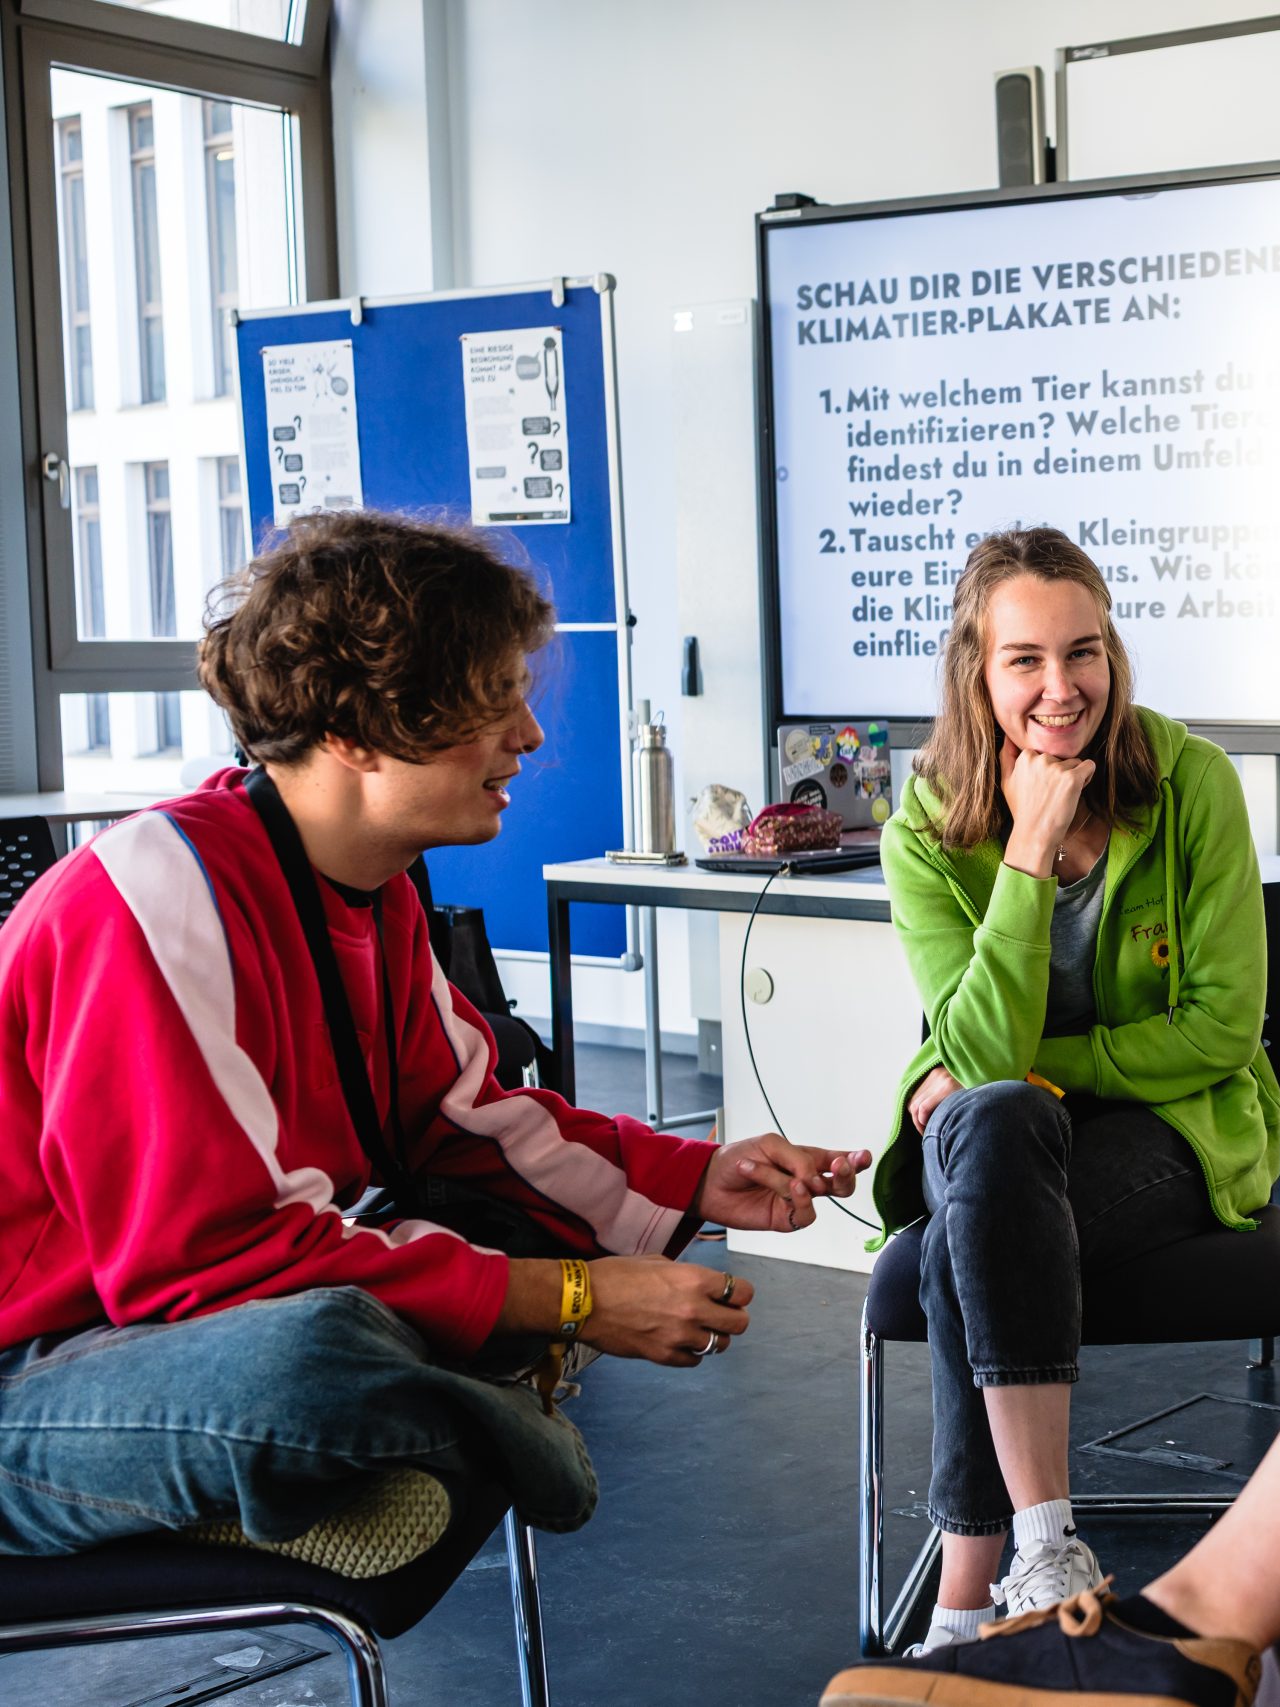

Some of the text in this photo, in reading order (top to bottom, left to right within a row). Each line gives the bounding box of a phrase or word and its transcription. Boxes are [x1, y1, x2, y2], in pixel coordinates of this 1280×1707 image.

[796, 277, 899, 311] SCHAU
[909, 272, 961, 302] DIR
[971, 266, 1022, 297] DIE
[797, 292, 1181, 346] KLIMATIER-PLAKATE AN:
[846, 385, 891, 413] Mit
[899, 377, 1022, 409] welchem
[1031, 374, 1092, 402] Tier
[1101, 368, 1206, 399] kannst
[1214, 360, 1255, 393] du
[847, 411, 1056, 449] identifizieren?
[1065, 404, 1182, 437] Welche
[847, 437, 1264, 483] findest du in deinem Umfeld
[848, 488, 964, 518] wieder?
[848, 523, 956, 555] Tauscht
[850, 568, 914, 588] eure
[1149, 554, 1213, 582] Wie
[851, 594, 895, 622] die
[1115, 599, 1167, 620] ure
[1176, 588, 1277, 620] Arbeit
